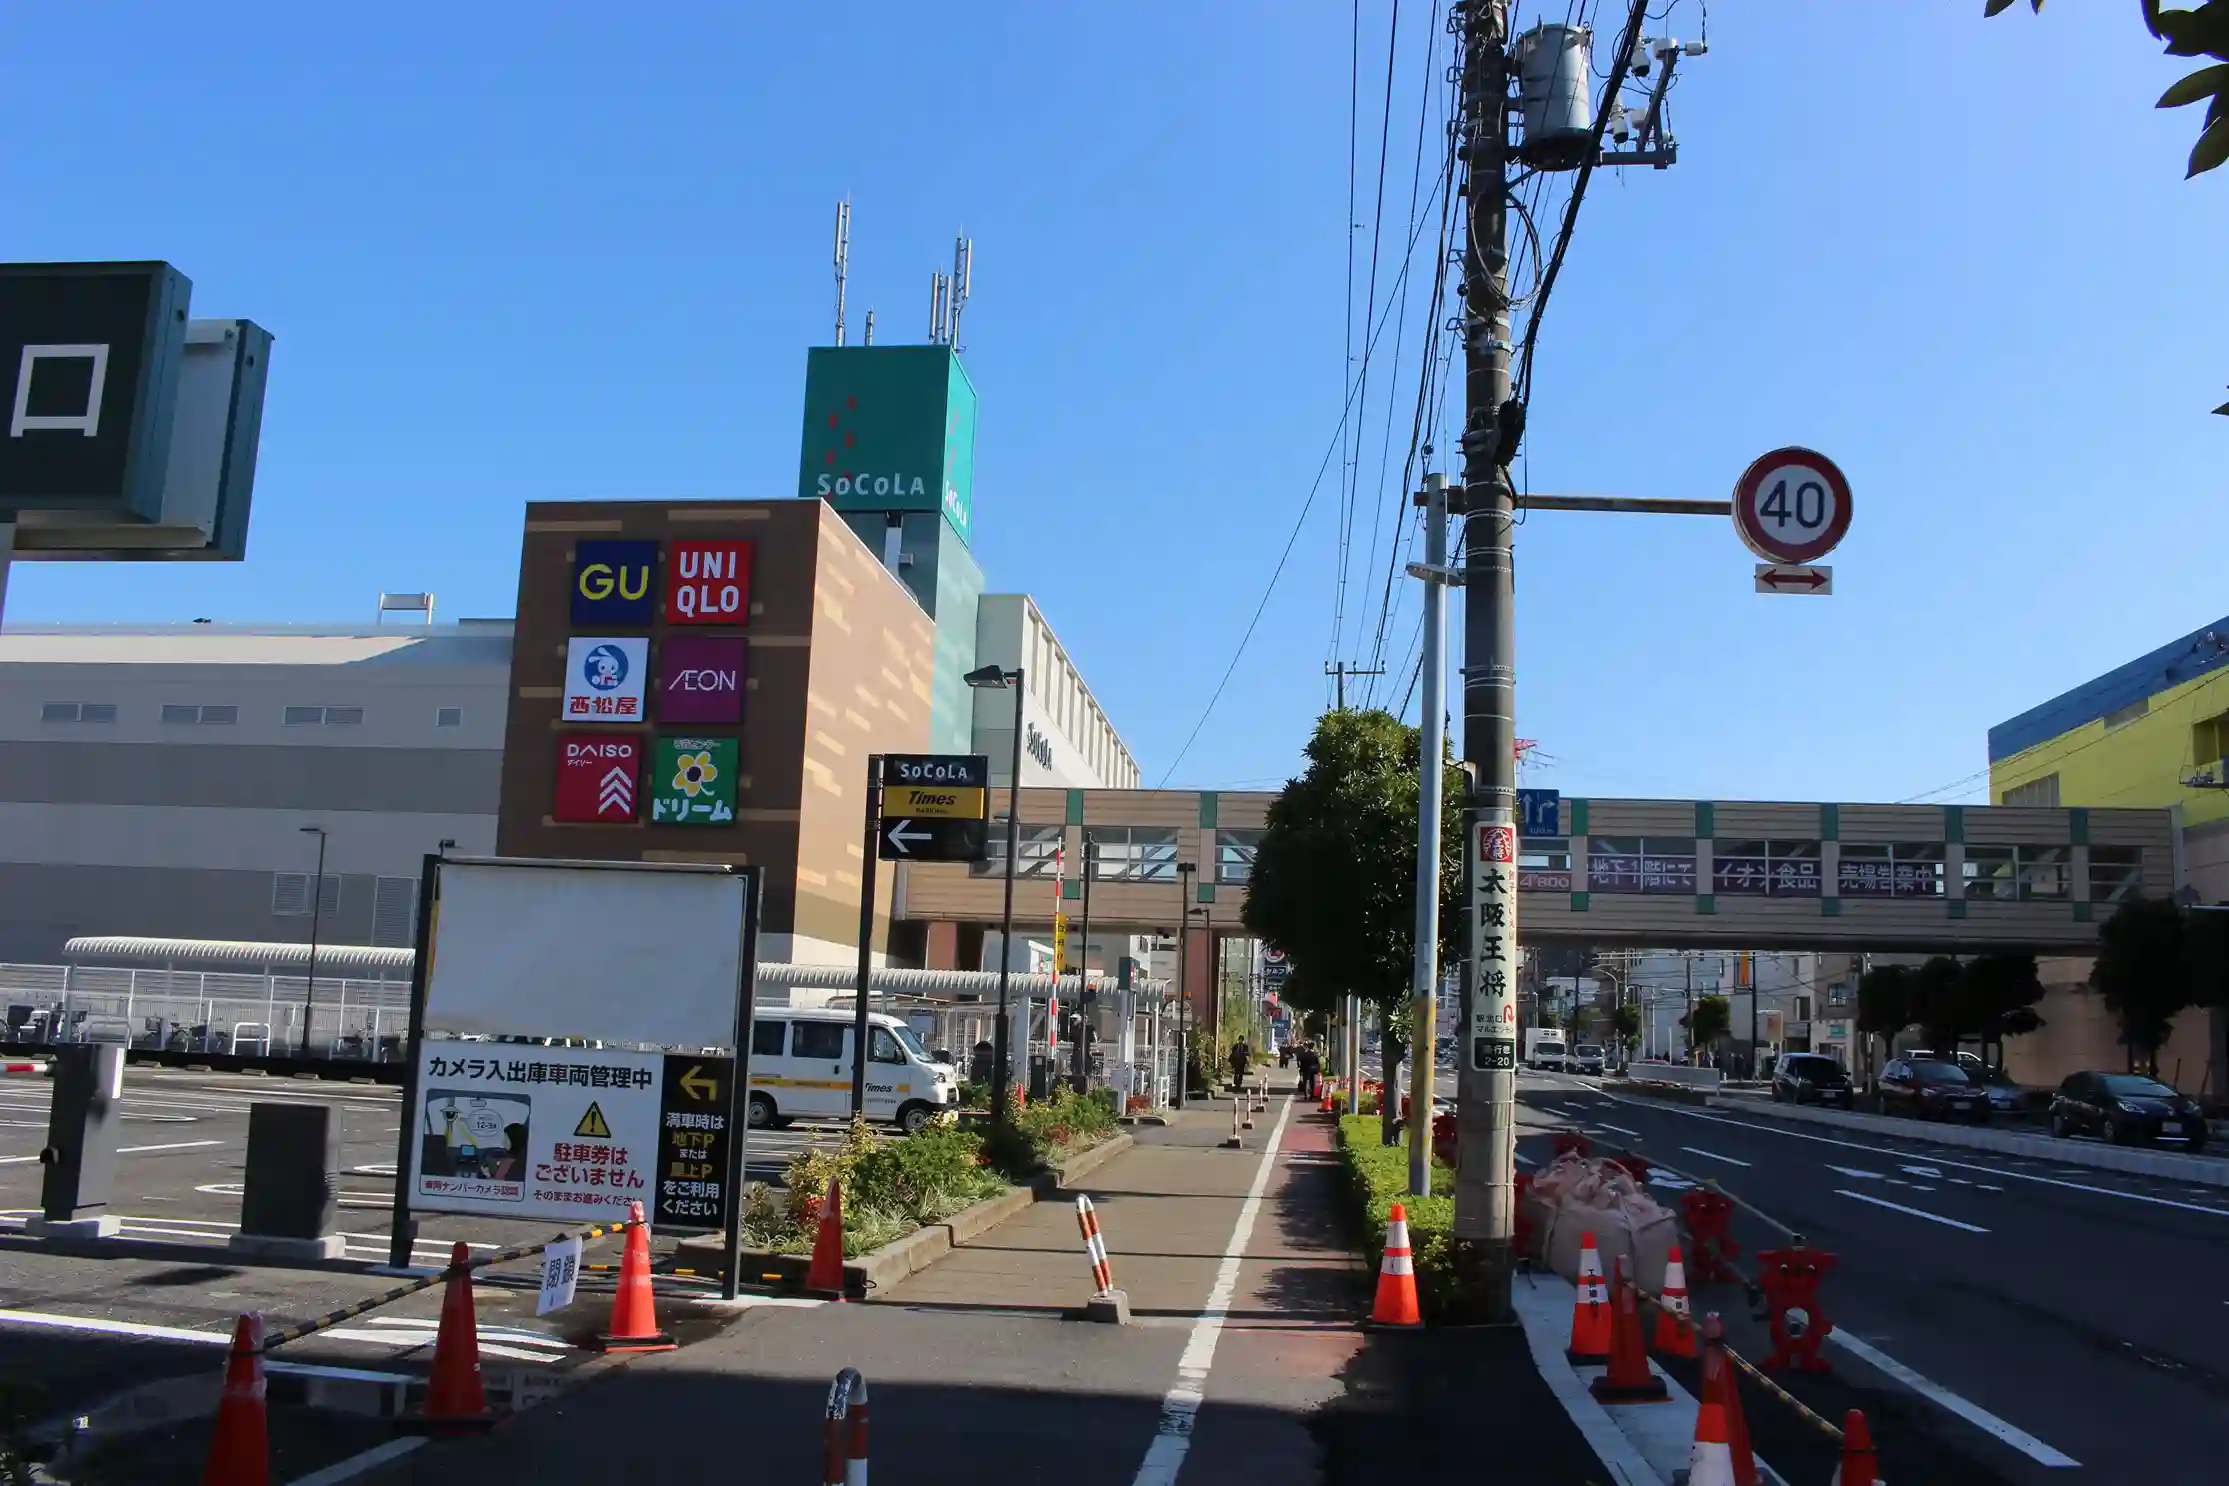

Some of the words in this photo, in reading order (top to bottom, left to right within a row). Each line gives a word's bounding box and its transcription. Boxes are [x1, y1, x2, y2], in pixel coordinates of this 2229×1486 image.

[1760, 480, 1825, 529] 40
[680, 551, 737, 579] UNI
[579, 564, 649, 601] GU
[677, 585, 740, 617] QLO
[569, 696, 638, 716] 西松屋
[567, 744, 632, 758] DAISO
[652, 798, 733, 821] ドリーム
[908, 791, 957, 806] Times
[1720, 862, 1818, 889] イオン食品
[1476, 868, 1508, 997] 大阪王将
[427, 1056, 653, 1090] カメラ入出庫車両管理中
[665, 1111, 725, 1130] 満車時は
[671, 1131, 715, 1147] 地下P
[552, 1142, 629, 1165] 駐車券は
[679, 1148, 708, 1160] または
[535, 1163, 645, 1189] ございません
[663, 1180, 720, 1199] をご利用
[661, 1199, 718, 1216] ください
